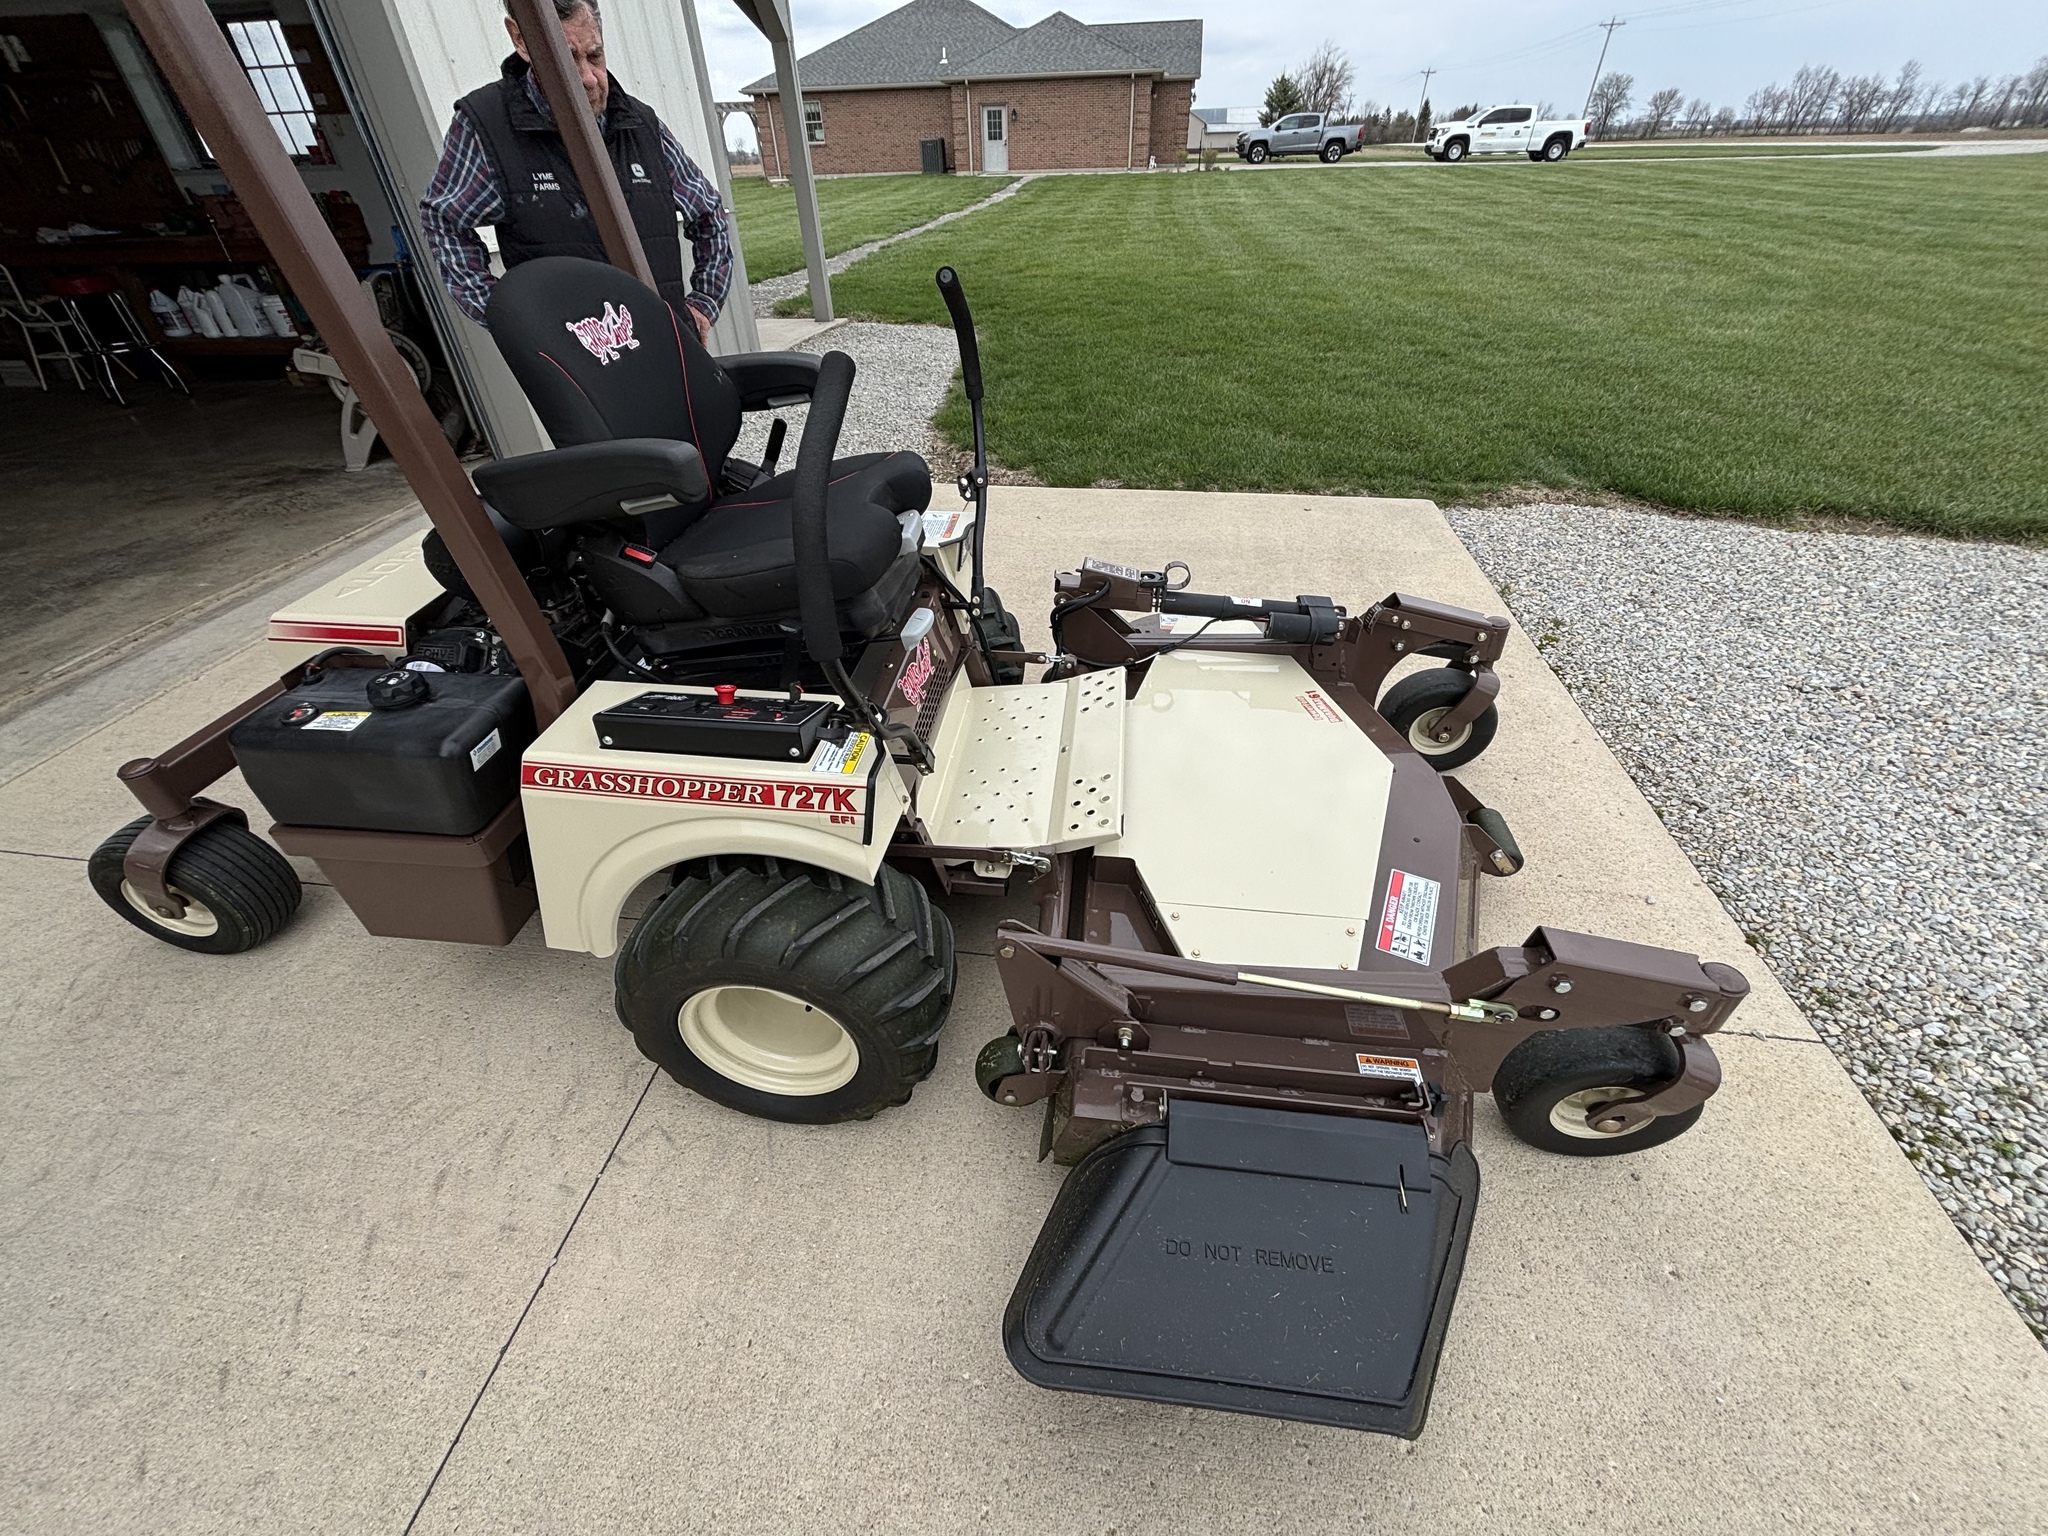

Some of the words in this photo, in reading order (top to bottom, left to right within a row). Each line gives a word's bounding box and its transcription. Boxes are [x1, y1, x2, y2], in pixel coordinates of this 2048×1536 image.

[532, 172, 555, 181] LYME
[534, 182, 561, 191] FARMS
[849, 735, 868, 762] CAUTION
[533, 767, 764, 804] GRASSHOPPER
[776, 784, 858, 812] 727K
[829, 815, 856, 825] EFI
[1386, 895, 1398, 924] DANGER
[1373, 1058, 1409, 1067] WARNING
[1166, 1239, 1191, 1257] DO
[1203, 1242, 1241, 1262] NOT
[1255, 1249, 1334, 1273] REMOVE
